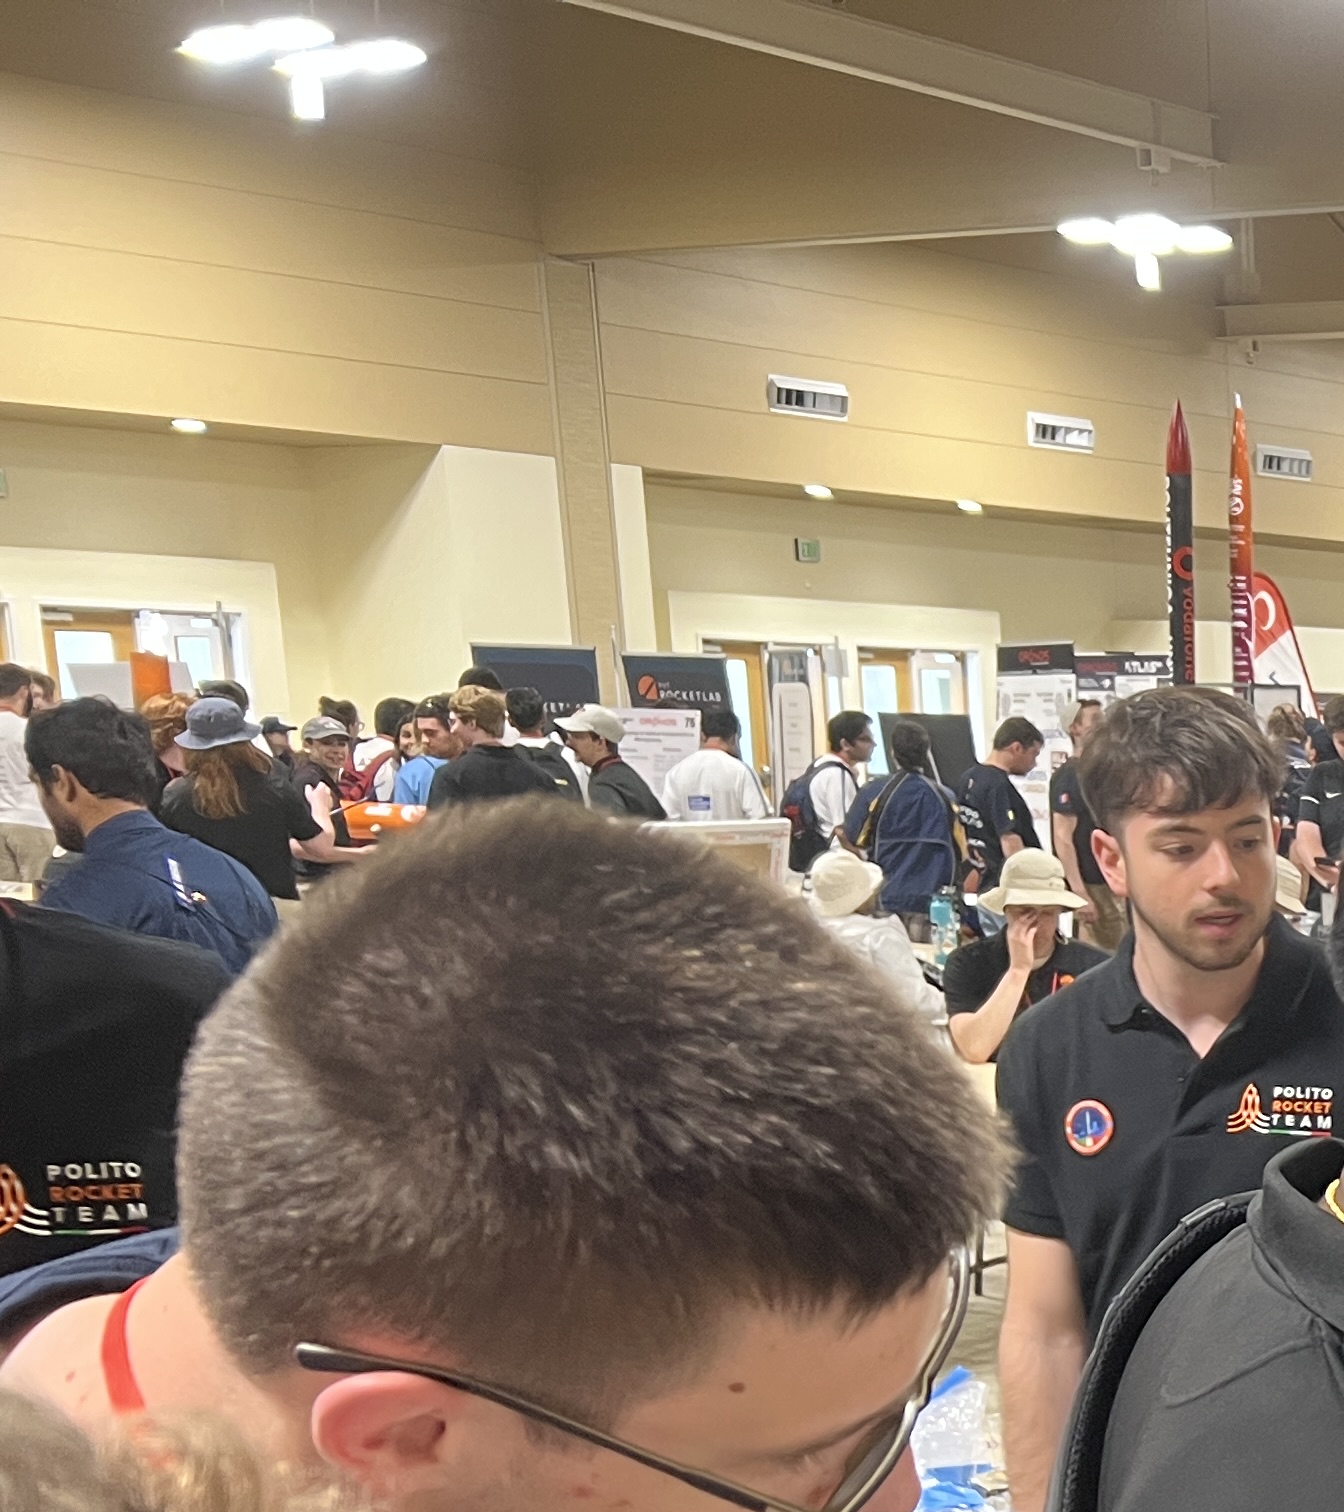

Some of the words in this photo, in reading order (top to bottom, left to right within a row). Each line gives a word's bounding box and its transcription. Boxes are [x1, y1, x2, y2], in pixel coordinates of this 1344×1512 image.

[1272, 1085, 1334, 1100] POLITO
[1271, 1100, 1334, 1114] ROCKET
[1270, 1114, 1333, 1129] TEAM
[46, 1161, 142, 1181] POLITO
[49, 1184, 144, 1200] ROCKET
[51, 1202, 148, 1224] TEAM
